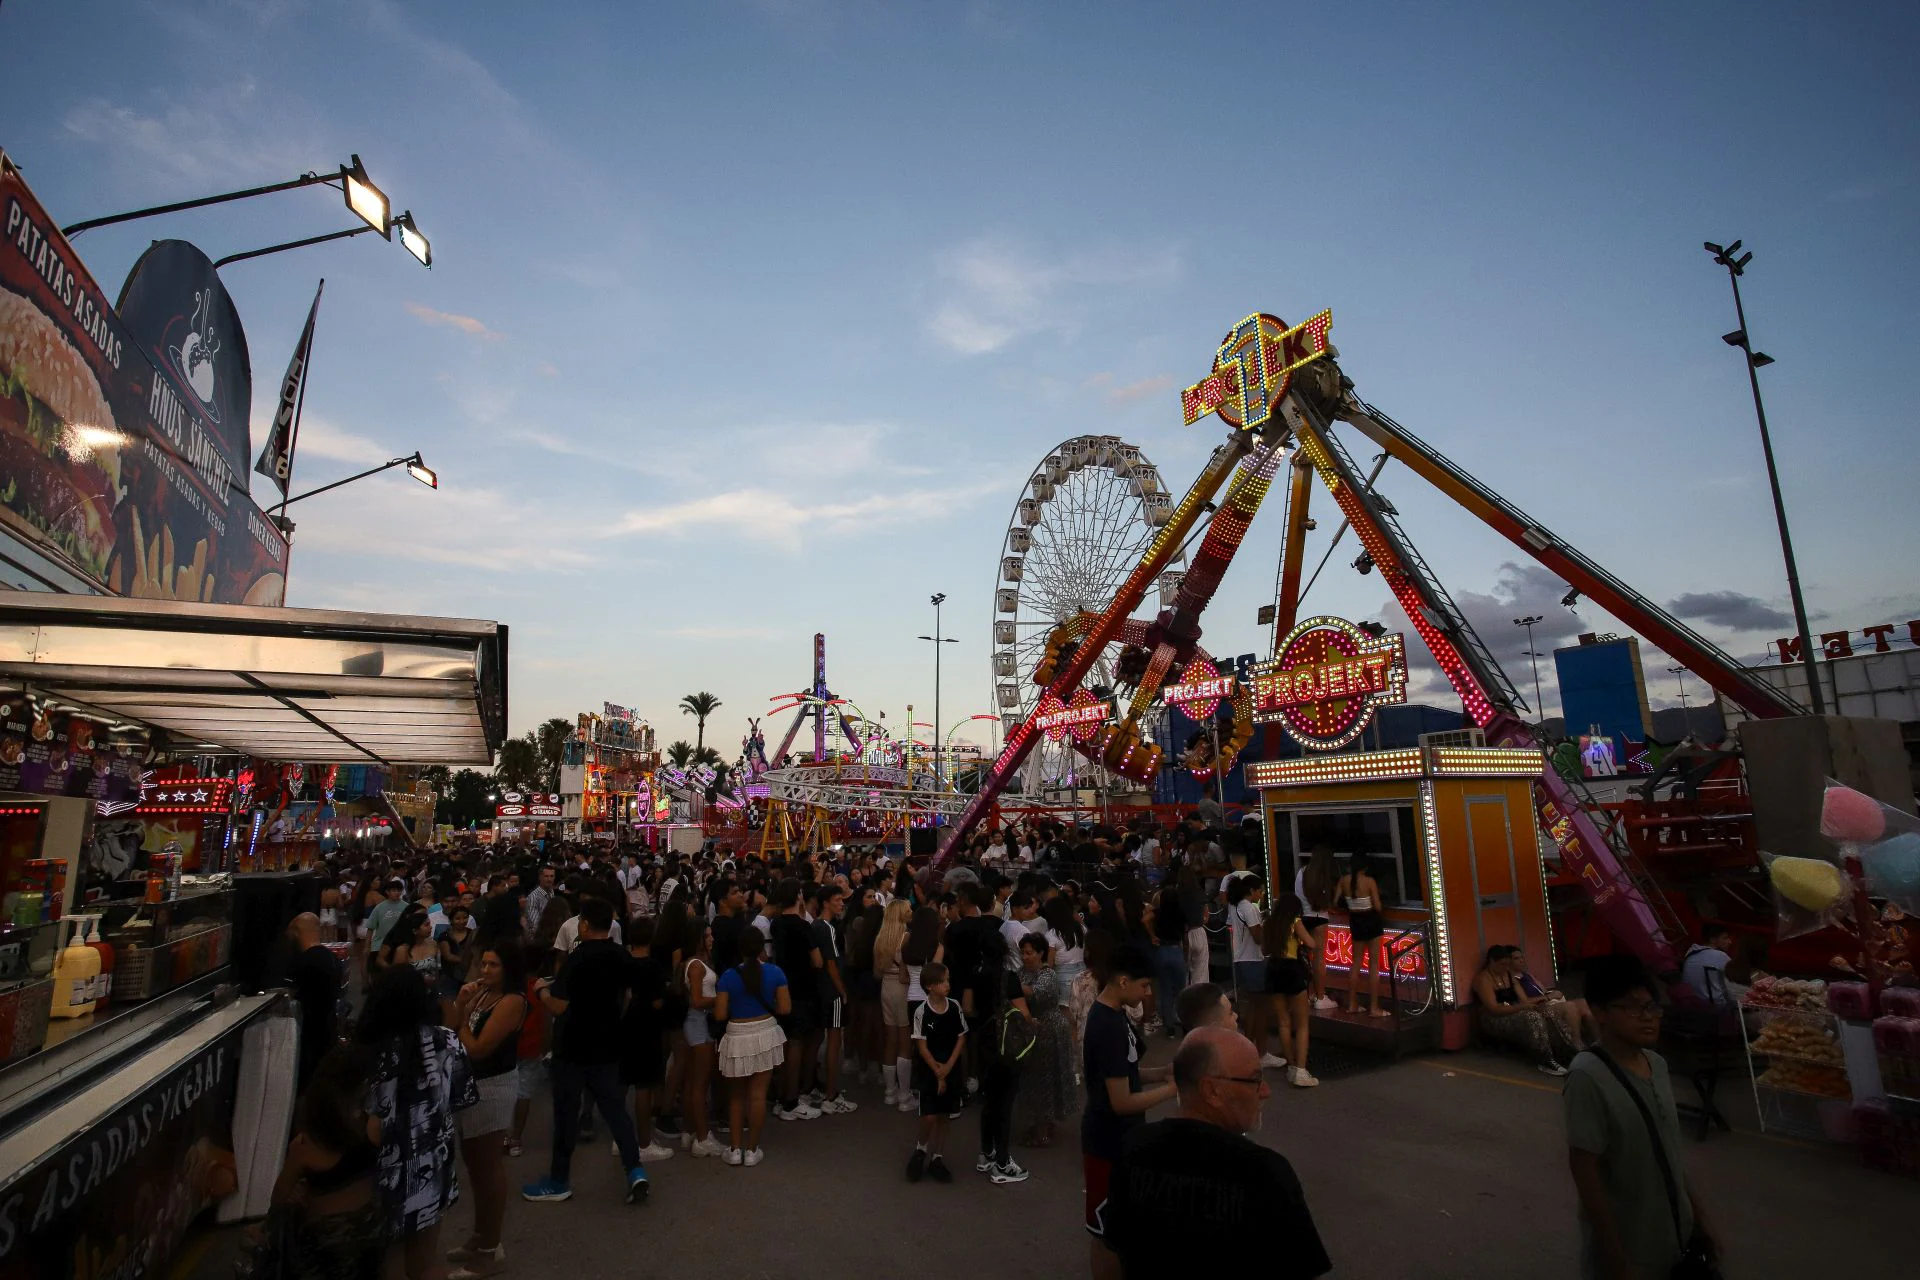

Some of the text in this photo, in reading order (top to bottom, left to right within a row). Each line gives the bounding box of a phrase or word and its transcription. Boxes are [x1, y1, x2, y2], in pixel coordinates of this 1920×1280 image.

[7, 200, 122, 369] PATATAS ASADAS
[144, 438, 225, 537] PATATAS ASADAS Y KEBAB
[1056, 703, 1108, 725] PROJEKT
[1163, 677, 1233, 704] PROJEKT
[1257, 655, 1386, 710] PROJEKT
[30, 1103, 155, 1234] ASADAS
[159, 1088, 172, 1133] Y
